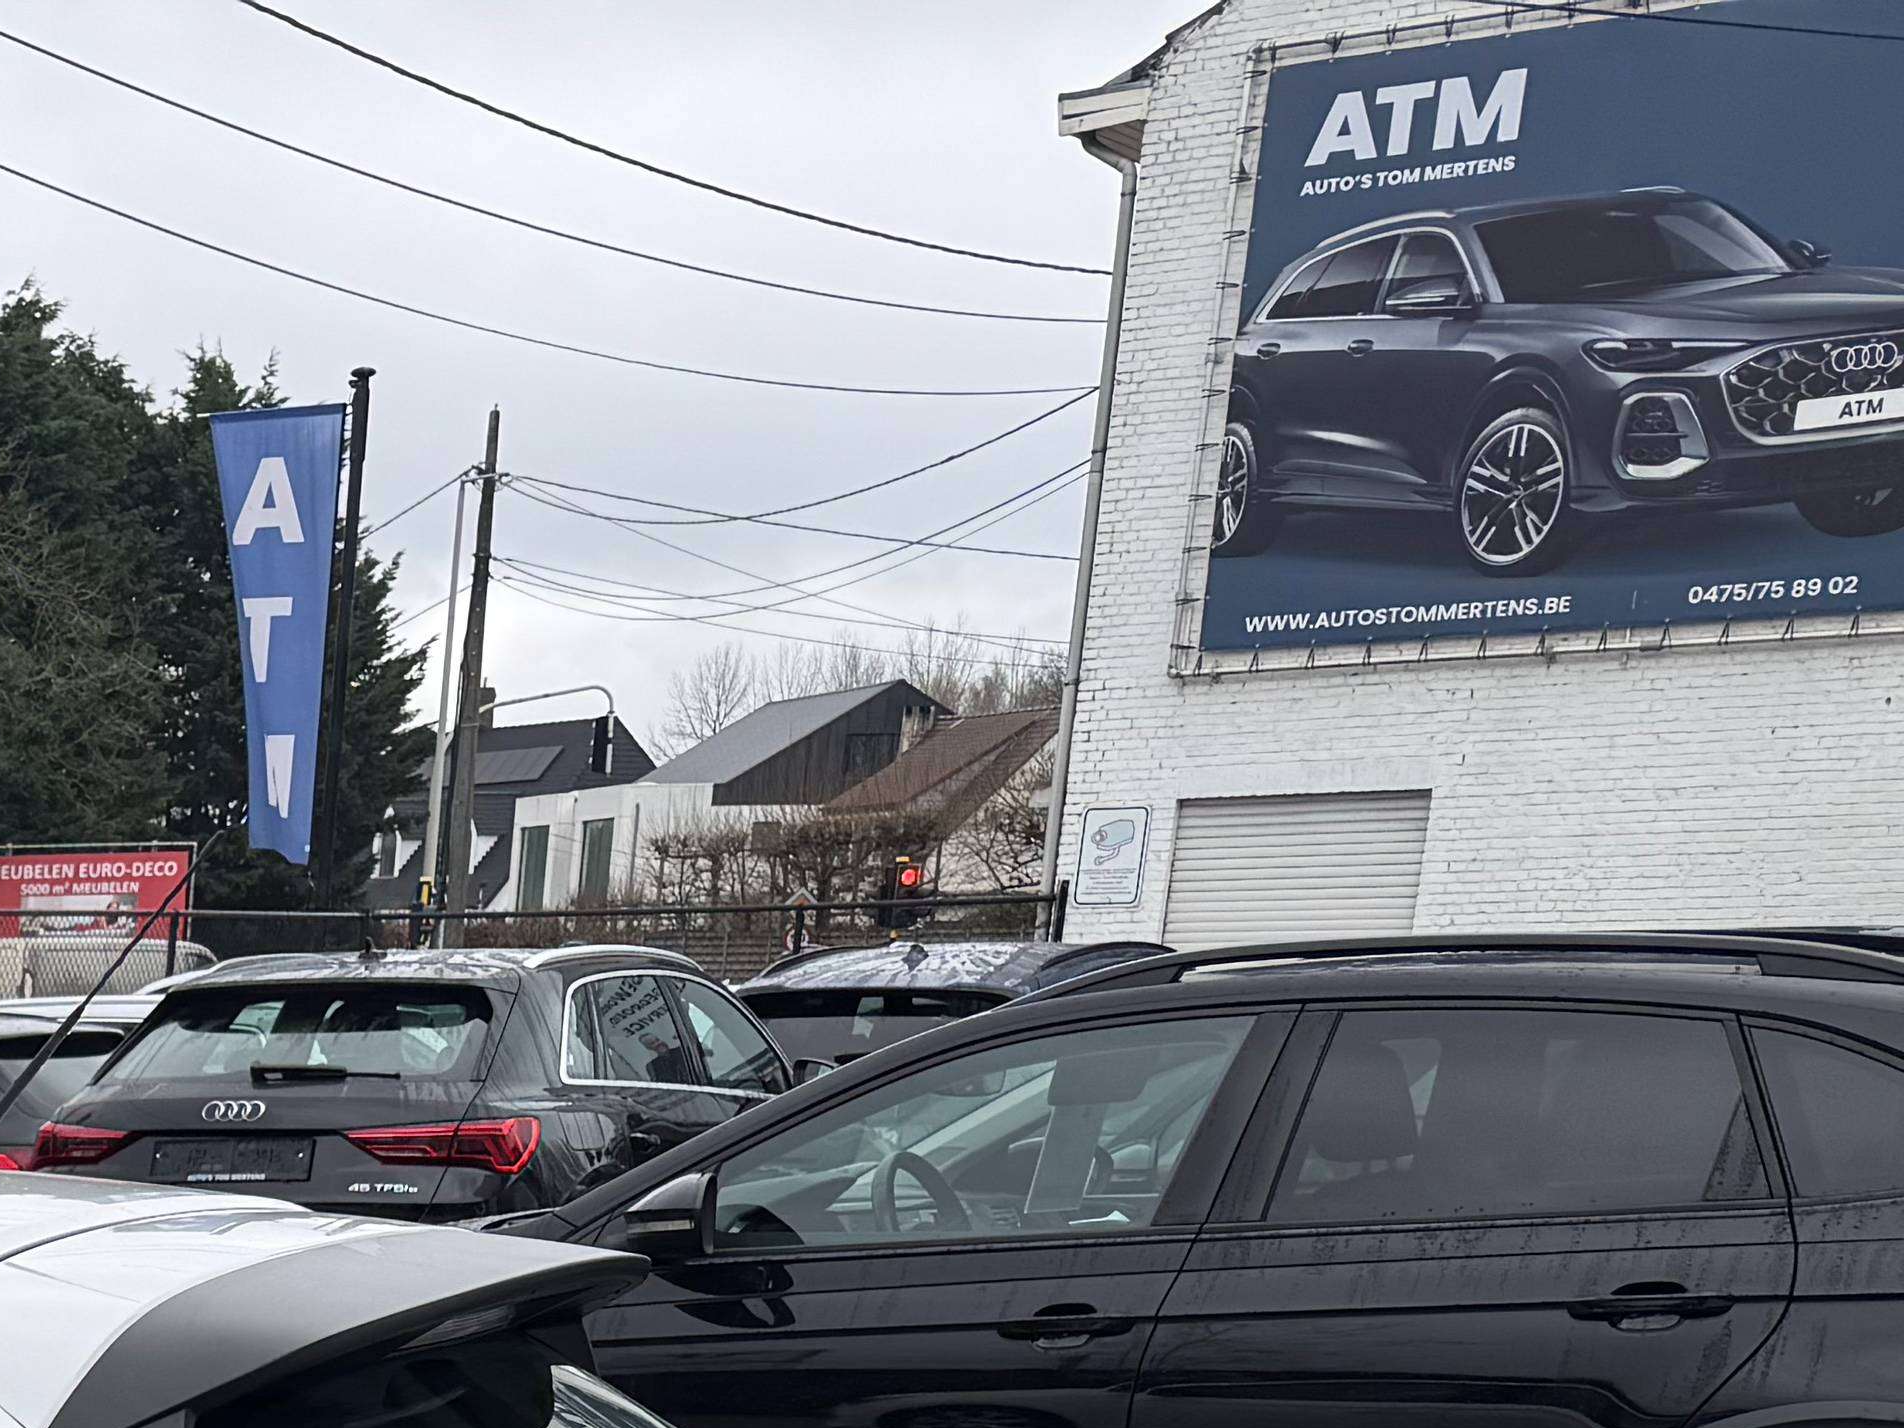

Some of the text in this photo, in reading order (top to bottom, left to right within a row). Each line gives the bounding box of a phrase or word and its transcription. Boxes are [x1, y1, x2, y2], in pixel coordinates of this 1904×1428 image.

[1304, 68, 1528, 167] ATM
[1300, 156, 1516, 197] AUTO'S TOM MERTENS
[1838, 398, 1885, 419] ATM
[1688, 576, 1858, 604] 0475/75 89 02
[1245, 596, 1572, 633] WWW.AUTOSTOMMERTENS.BE
[78, 861, 178, 878] EURO-DECO
[20, 883, 50, 895] 5000
[72, 881, 140, 893] MEUBELEN
